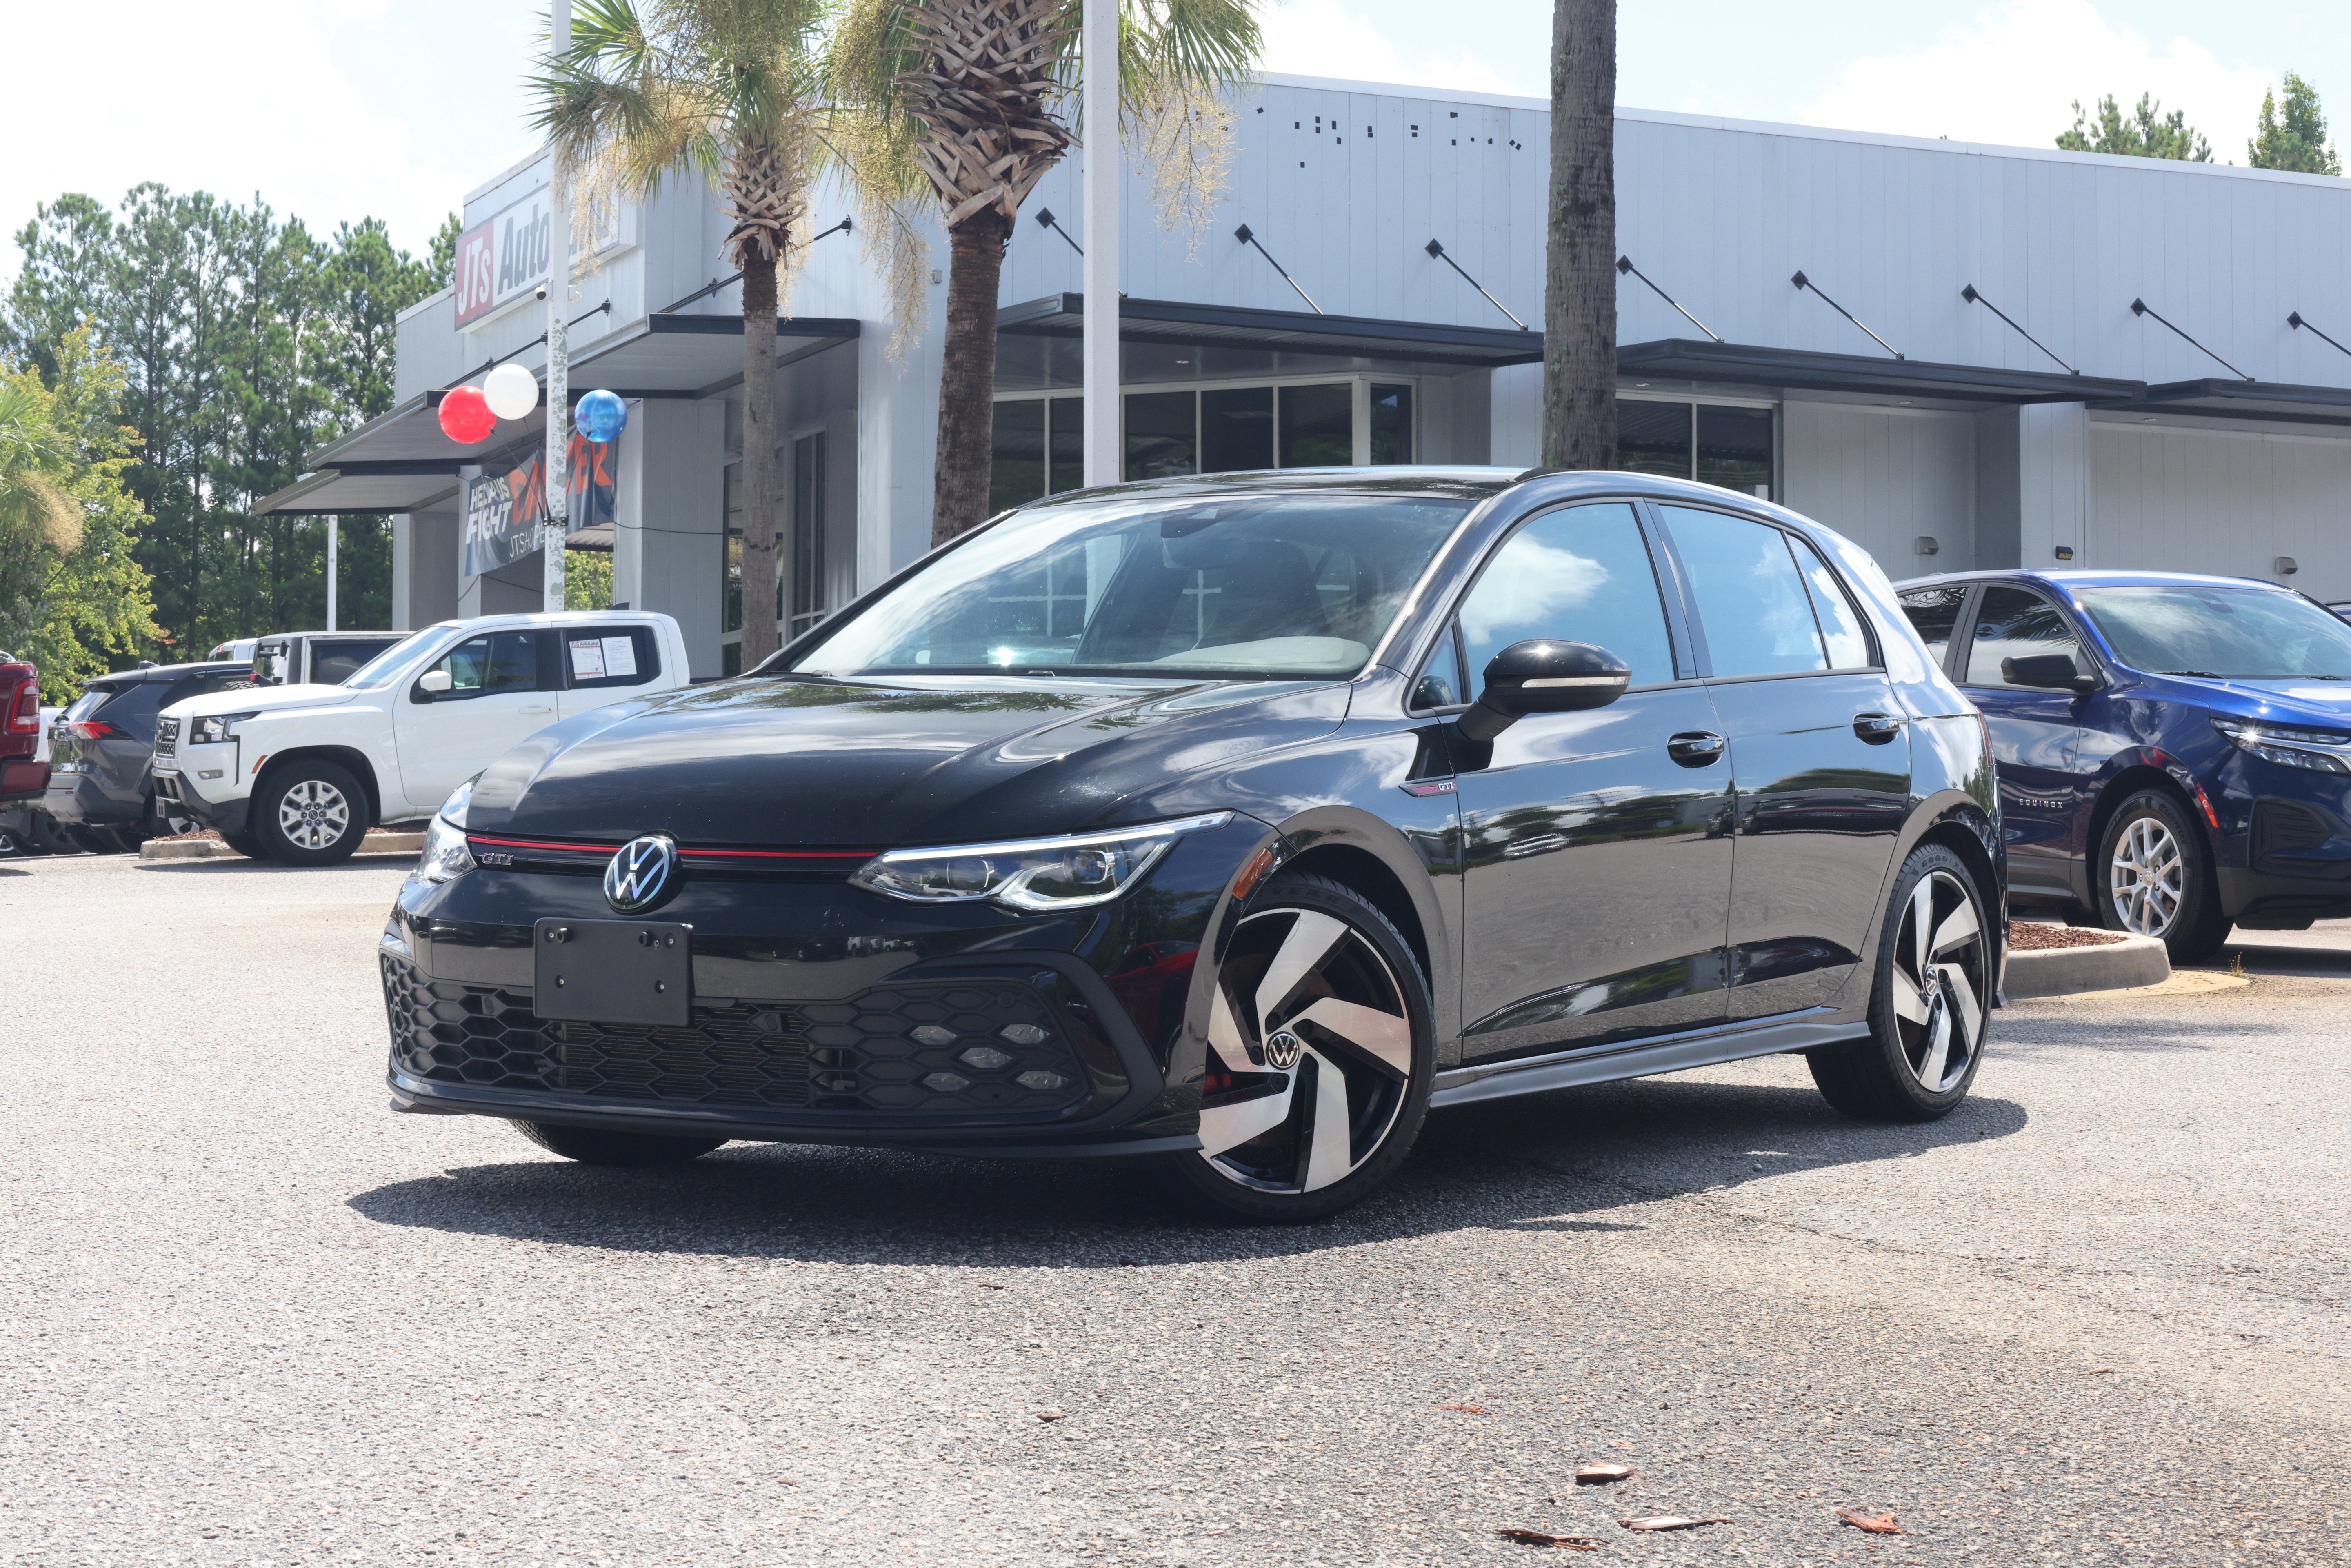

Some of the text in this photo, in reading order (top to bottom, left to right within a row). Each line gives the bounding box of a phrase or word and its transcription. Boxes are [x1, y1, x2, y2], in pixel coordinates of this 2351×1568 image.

[458, 236, 491, 316] JTs
[470, 476, 510, 511] HELP US
[509, 434, 612, 526] CAER
[466, 500, 513, 544] FIGHT
[1438, 782, 1454, 791] GTI
[2019, 799, 2063, 808] EQUINOX
[481, 852, 514, 866] GTI
[1270, 1034, 1297, 1066] VW
